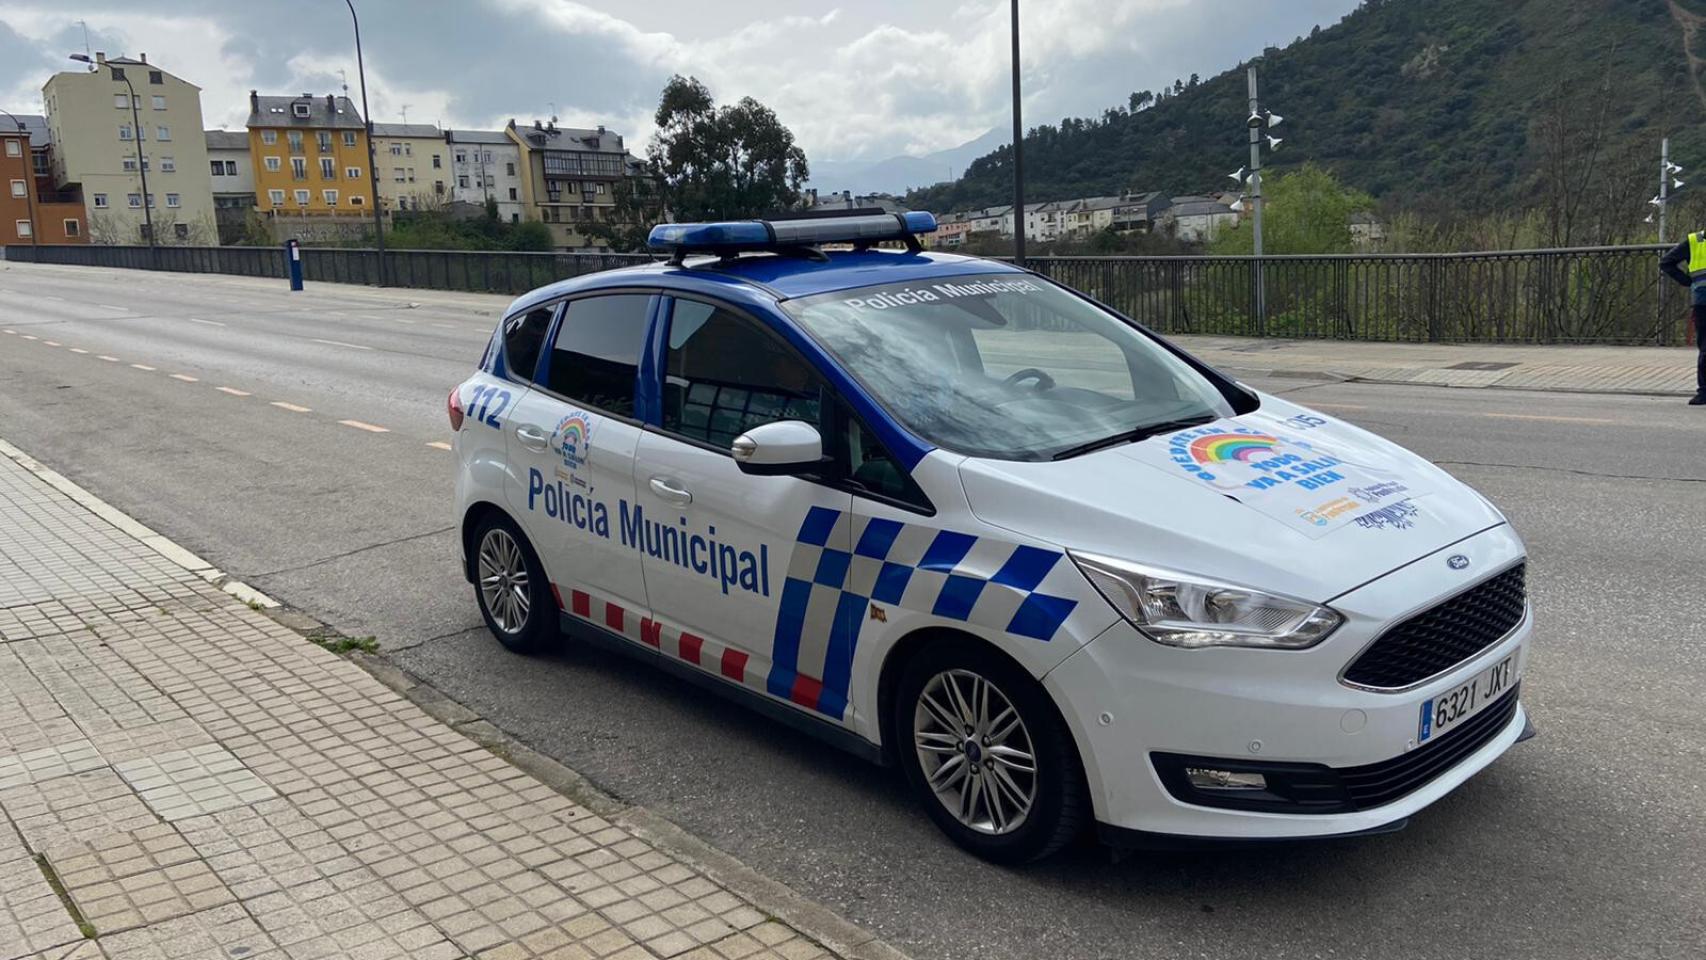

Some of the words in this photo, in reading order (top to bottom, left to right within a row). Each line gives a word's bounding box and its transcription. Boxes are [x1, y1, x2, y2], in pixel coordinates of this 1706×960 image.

[932, 279, 1044, 298] Municipal
[467, 384, 511, 430] 112
[1250, 454, 1302, 472] TODO
[1245, 477, 1283, 490] VA
[1275, 471, 1299, 481] A
[1295, 469, 1345, 490] BIEN
[529, 466, 610, 539] Policía
[619, 499, 769, 597] Municipal
[1436, 680, 1477, 728] 6321
[1484, 657, 1511, 699] JXT
